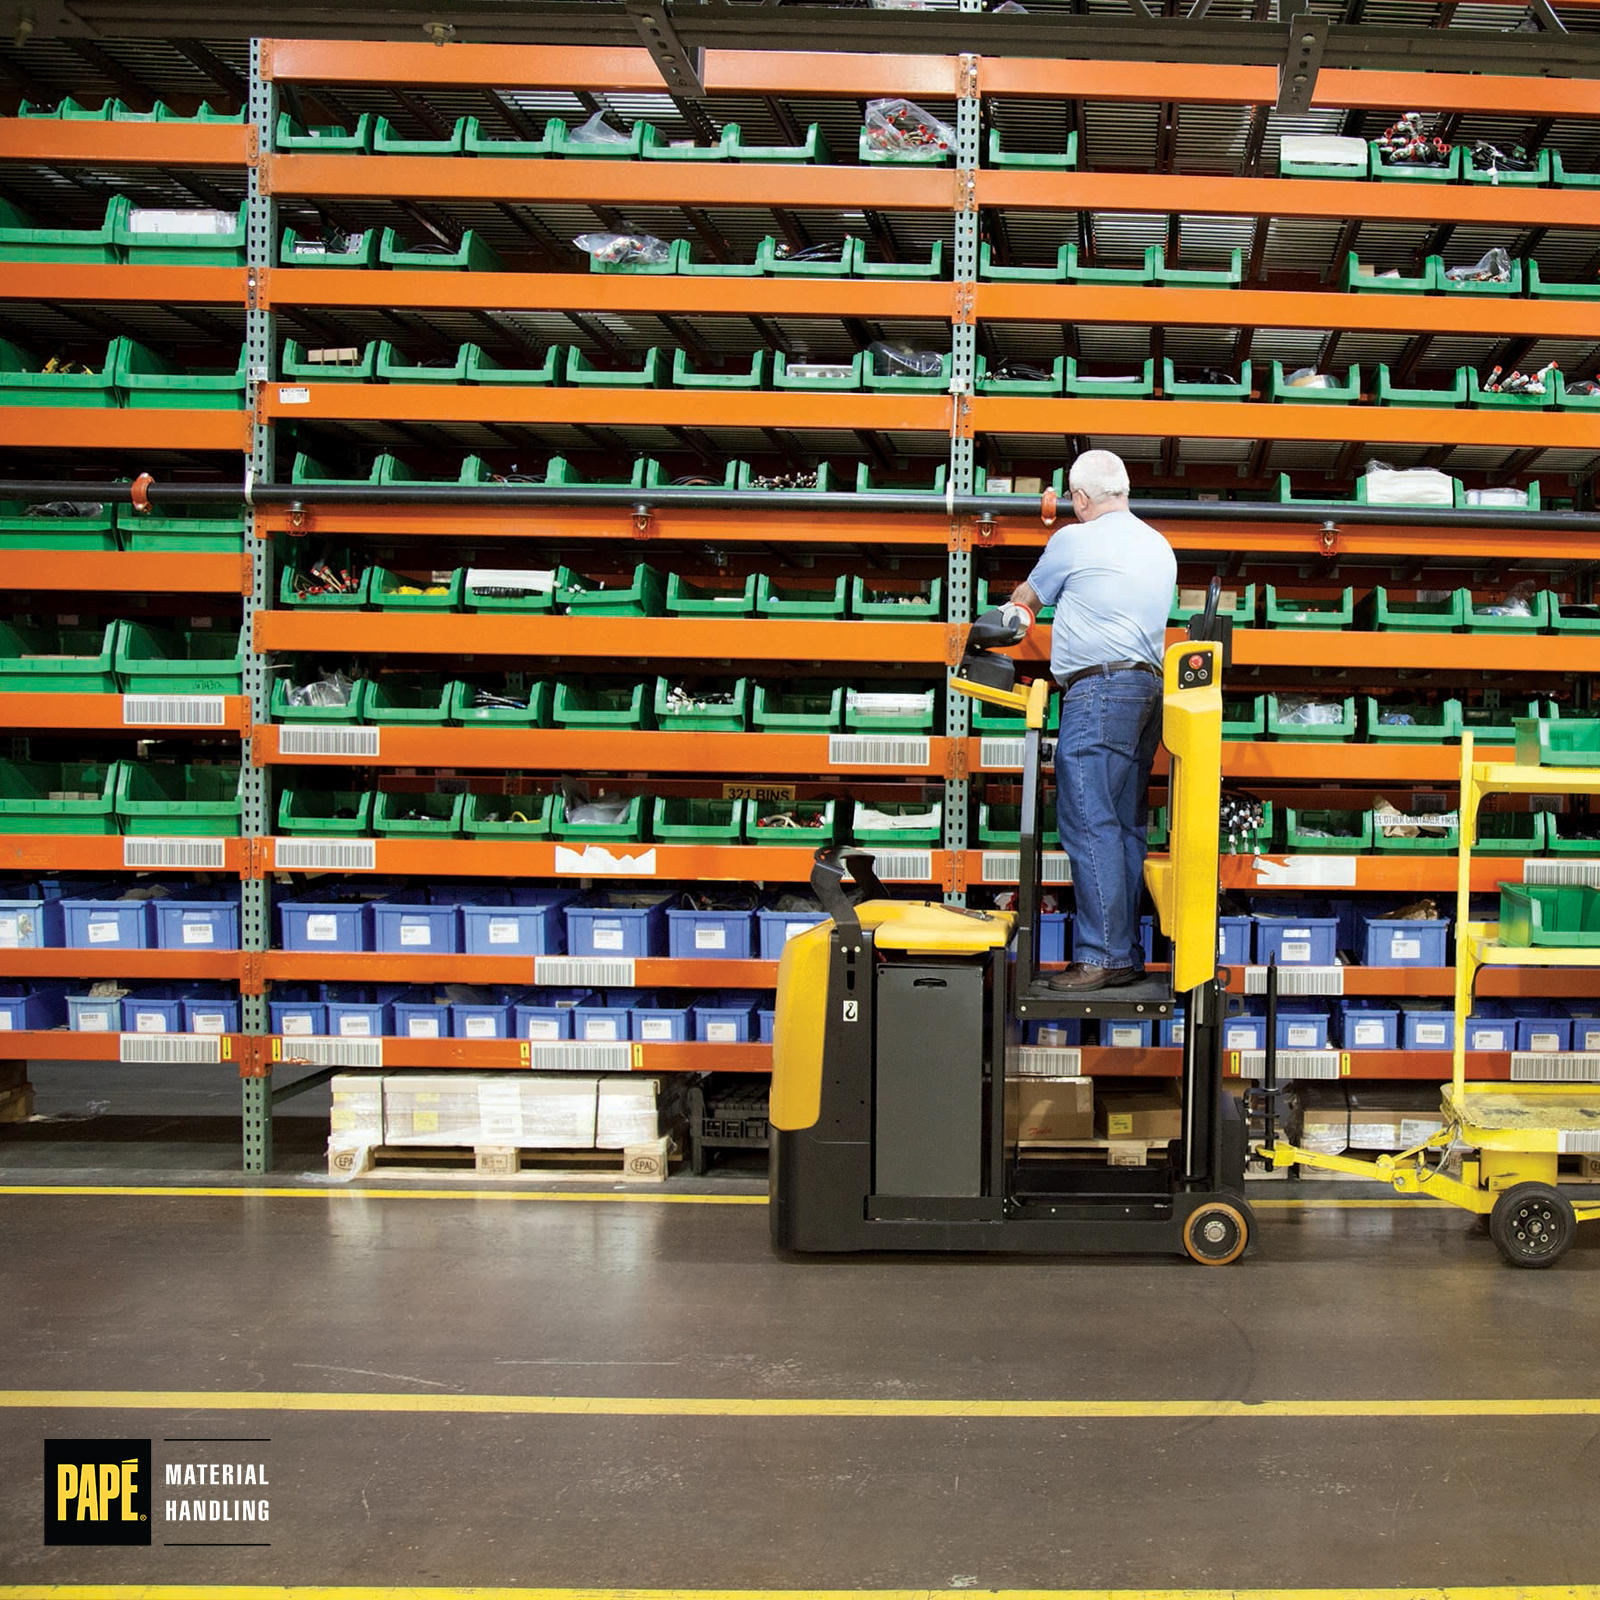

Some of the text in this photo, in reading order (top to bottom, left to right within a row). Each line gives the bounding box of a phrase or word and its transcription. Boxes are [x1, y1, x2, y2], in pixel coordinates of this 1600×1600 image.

[728, 788, 790, 800] 321 BINS
[1383, 815, 1404, 825] OTHER
[1405, 815, 1440, 825] CONTAINER
[1441, 816, 1458, 825] FIRST
[338, 1157, 354, 1167] EPA
[635, 1160, 653, 1170] EPAL
